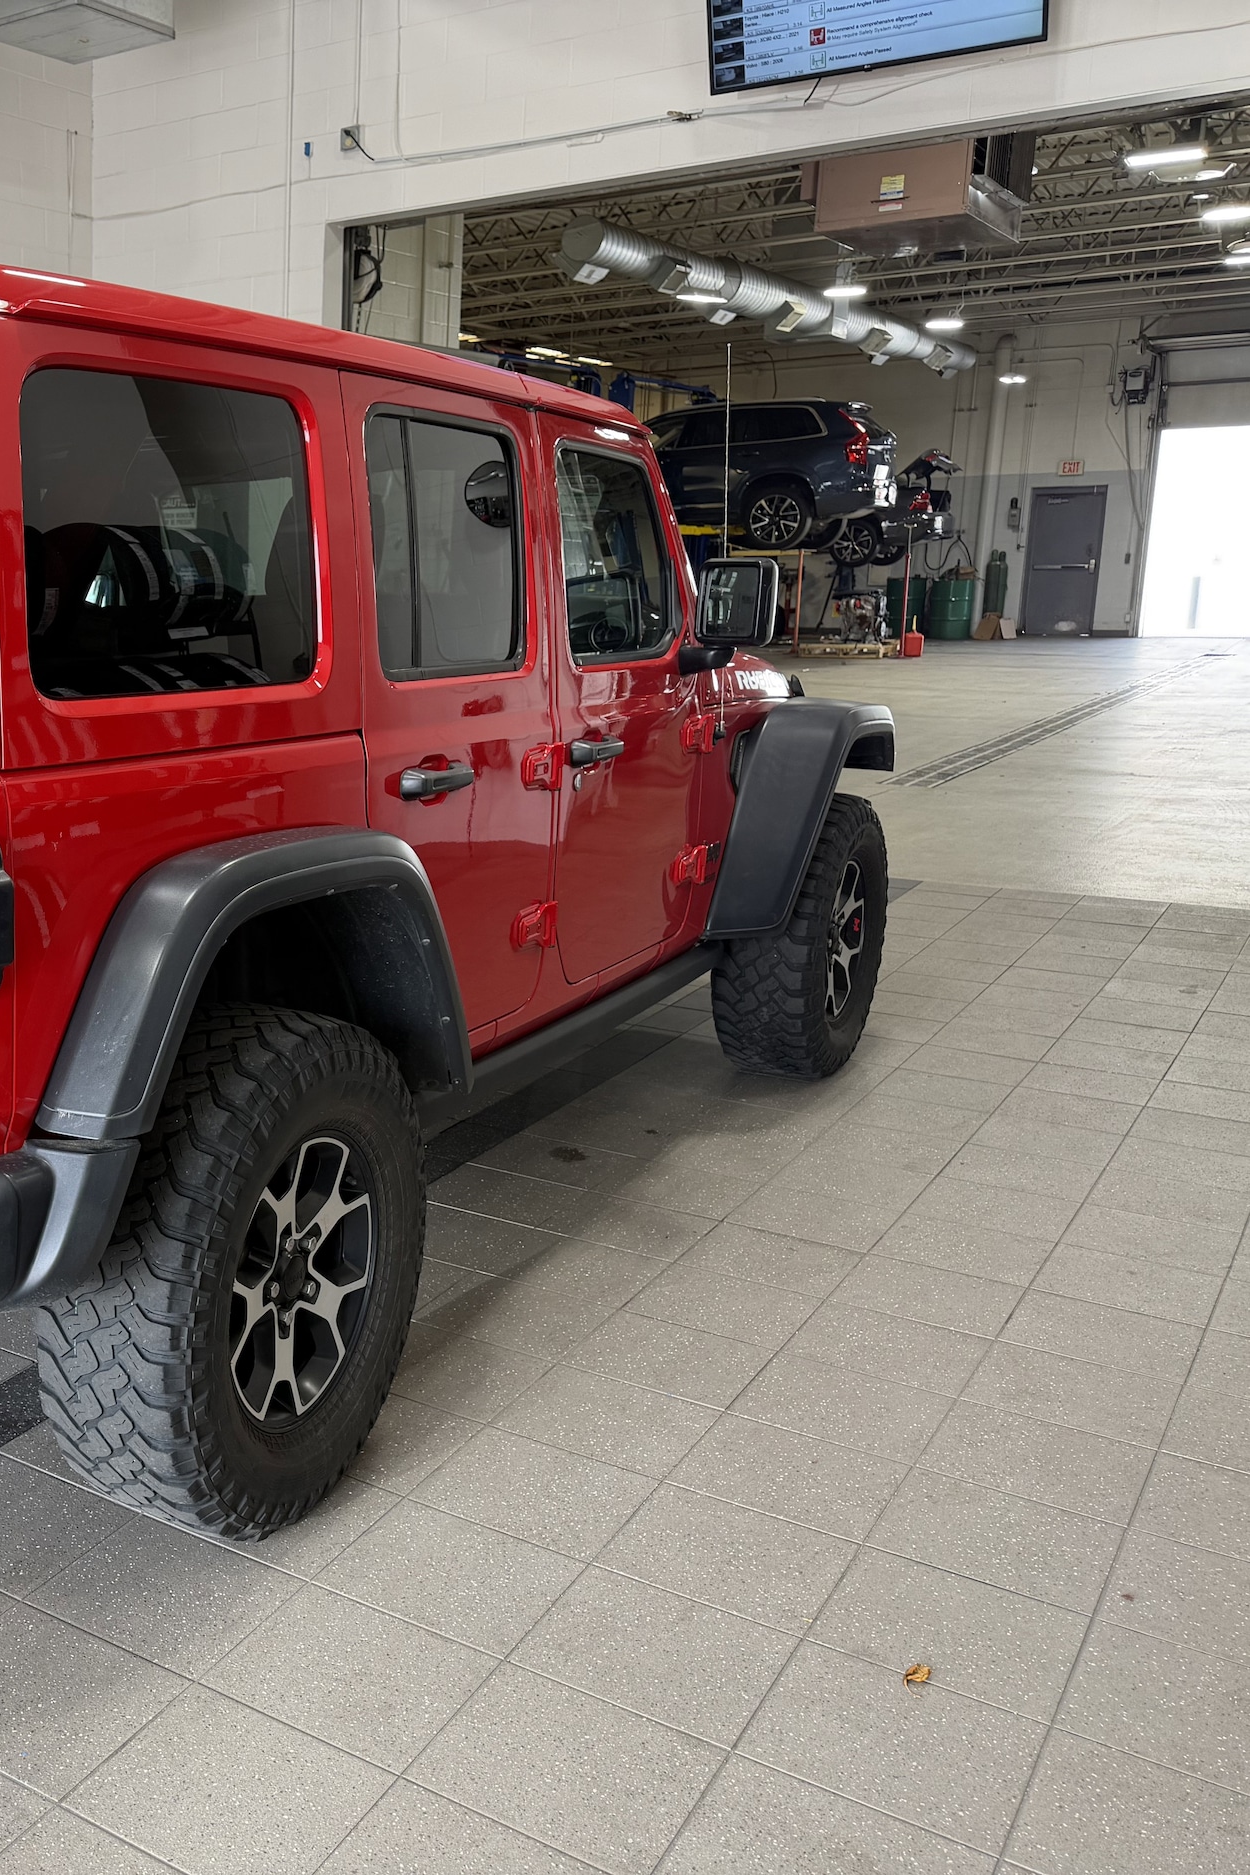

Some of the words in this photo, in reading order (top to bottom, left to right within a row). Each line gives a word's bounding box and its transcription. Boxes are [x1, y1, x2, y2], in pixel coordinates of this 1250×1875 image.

[833, 3, 855, 12] Measured
[826, 25, 855, 34] Recommend
[860, 18, 895, 29] comprehensive
[895, 13, 918, 23] alignment
[918, 10, 933, 18] check
[858, 28, 873, 36] Safety
[874, 25, 892, 34] System
[835, 52, 858, 61] Measured
[1062, 461, 1081, 473] EXIT
